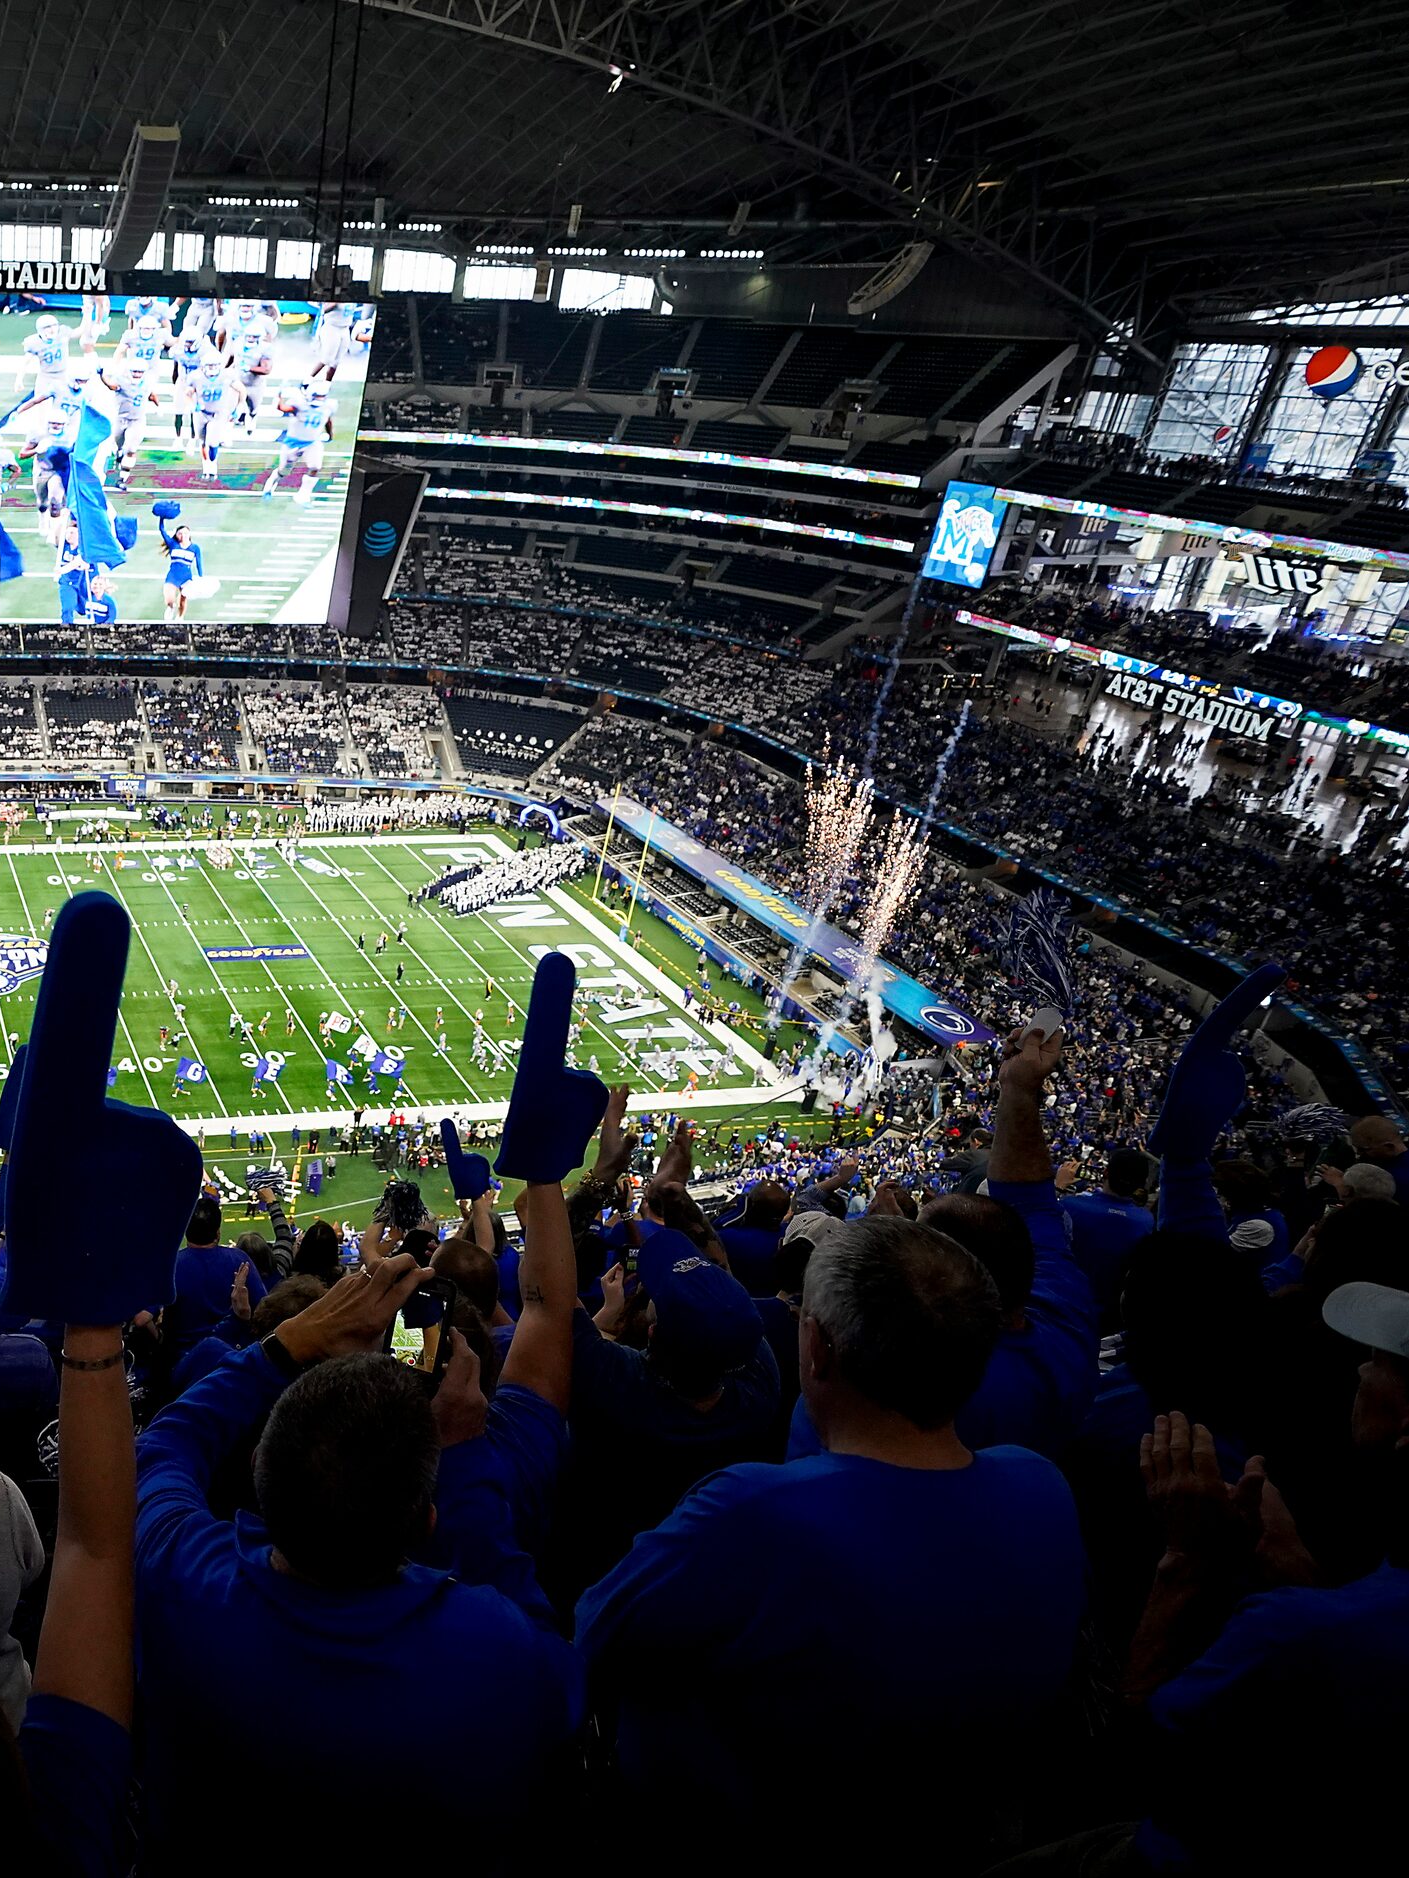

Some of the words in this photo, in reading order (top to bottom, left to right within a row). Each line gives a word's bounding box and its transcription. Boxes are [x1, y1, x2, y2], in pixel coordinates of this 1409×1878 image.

[1078, 517, 1108, 536] Lite
[1181, 534, 1212, 552] Lite
[1327, 544, 1374, 560] Memphis
[1242, 552, 1323, 595] Lite
[1105, 673, 1164, 707] AT&T
[1162, 687, 1275, 741] STADIUM
[715, 869, 809, 928] GOODYEAR
[666, 914, 706, 946] GOODYEAR
[207, 947, 306, 958] GOODYEAR
[117, 1056, 163, 1073] 40
[240, 1051, 285, 1068] 30
[380, 1059, 398, 1074] S
[186, 1062, 202, 1082] G
[263, 1063, 281, 1081] E
